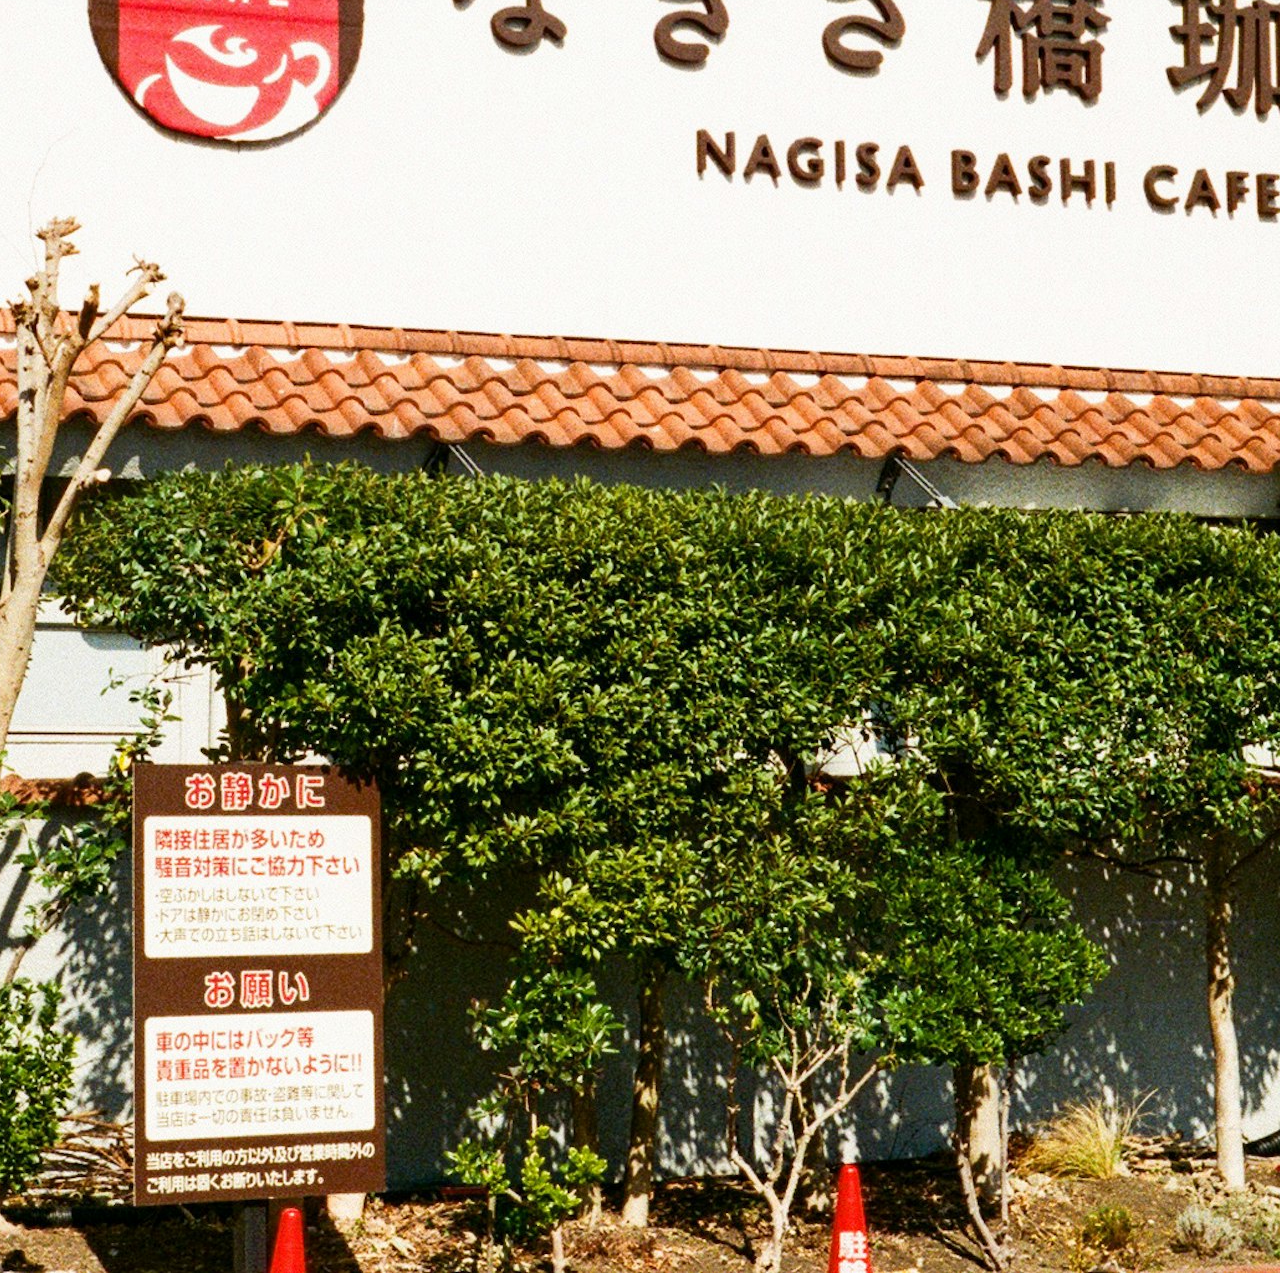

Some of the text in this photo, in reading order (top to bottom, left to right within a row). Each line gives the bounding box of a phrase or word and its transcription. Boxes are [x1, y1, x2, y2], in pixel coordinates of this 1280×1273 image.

[696, 129, 925, 193] NAGISA
[950, 149, 1117, 209] BASHI
[185, 772, 326, 811] お静かに
[155, 829, 326, 852] 隣接住居が多いため
[155, 854, 360, 879] 騒音対策にご協力下さい
[204, 970, 311, 1008] お願い
[156, 1026, 315, 1054] 車の中にはバッグ等
[146, 1142, 376, 1171] 当店をご利用の方以外及び営業時間外の
[146, 1169, 325, 1194] ご利用は固くお断りいたします。
